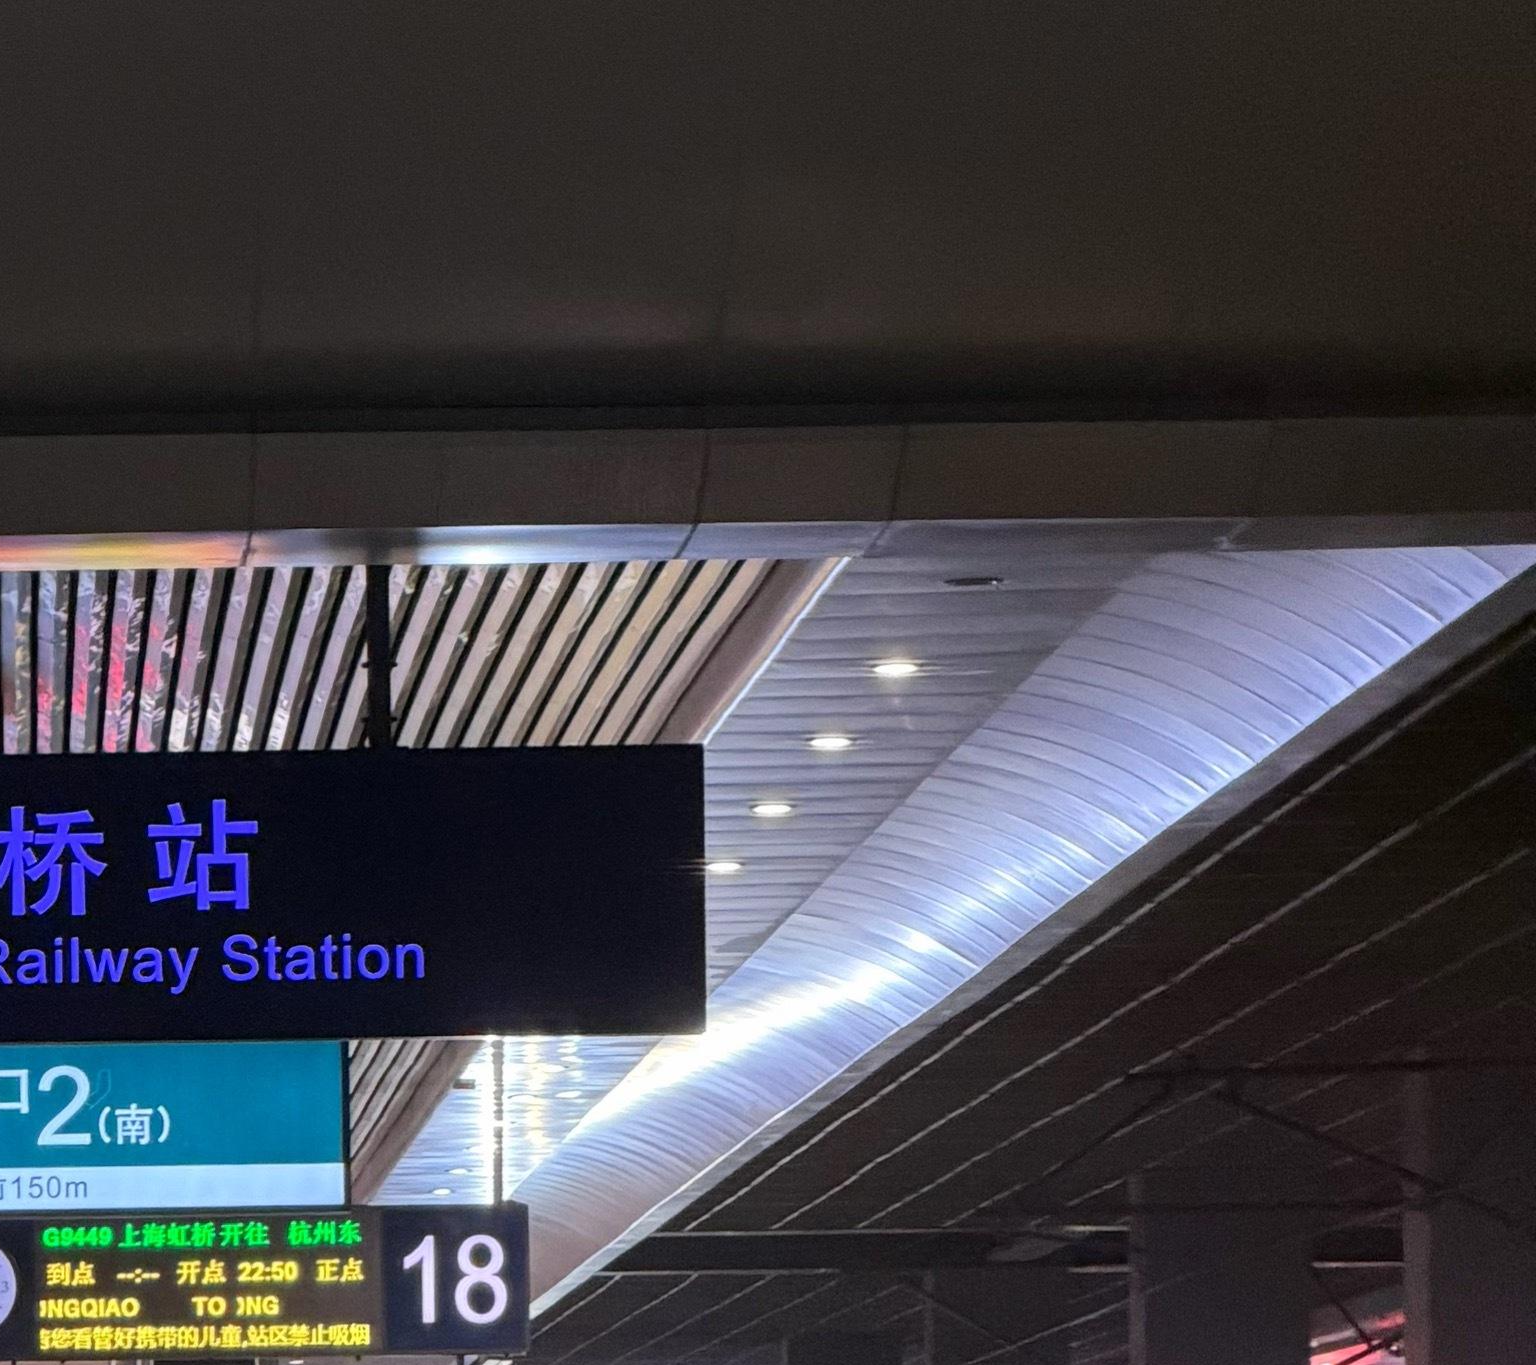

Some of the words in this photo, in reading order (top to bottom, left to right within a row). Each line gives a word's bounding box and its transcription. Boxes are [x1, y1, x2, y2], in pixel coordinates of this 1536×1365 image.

[221, 932, 426, 983] Station
[287, 1218, 363, 1246] 杭州东
[46, 1260, 96, 1286] 到点
[176, 1258, 227, 1285] 开点
[237, 1260, 299, 1283] 22:50
[316, 1256, 364, 1283] 正点
[402, 1233, 509, 1325] 18
[191, 1296, 227, 1317] TO
